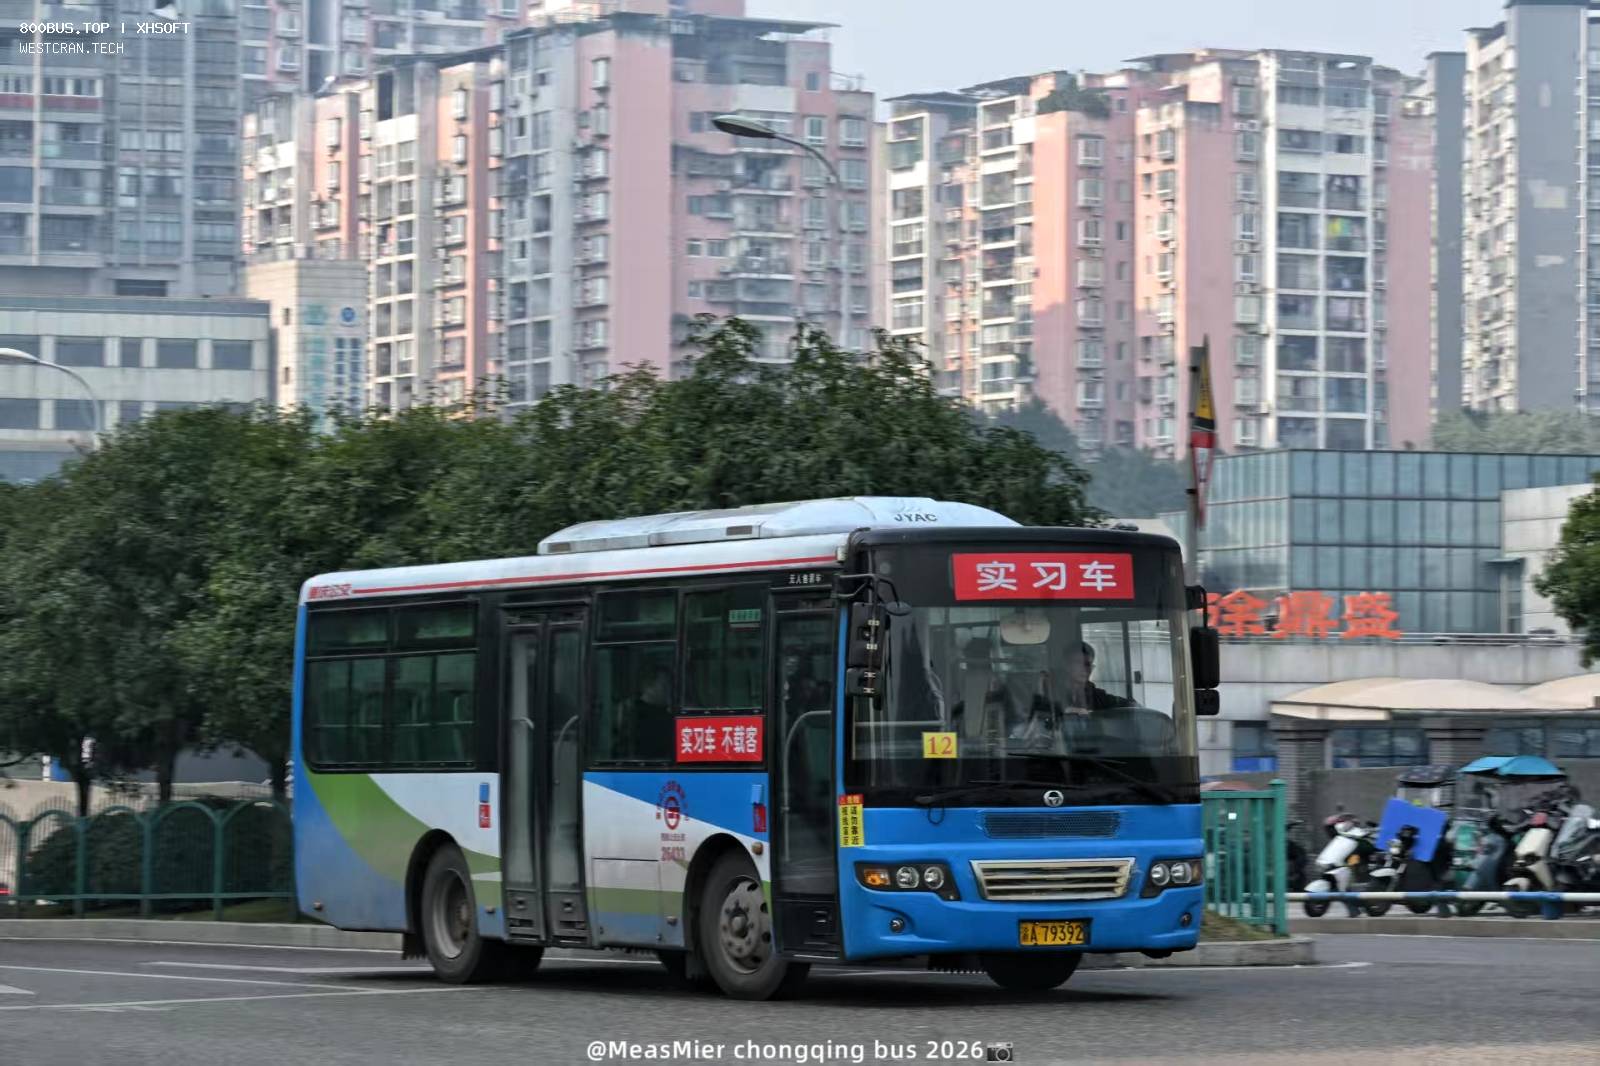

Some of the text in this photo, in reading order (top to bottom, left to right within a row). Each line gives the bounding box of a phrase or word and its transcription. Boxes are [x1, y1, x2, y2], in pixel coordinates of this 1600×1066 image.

[894, 513, 938, 523] JYAC
[976, 561, 1117, 592] 实习车
[681, 726, 758, 754] 实习车 不载客
[927, 736, 953, 755] 12
